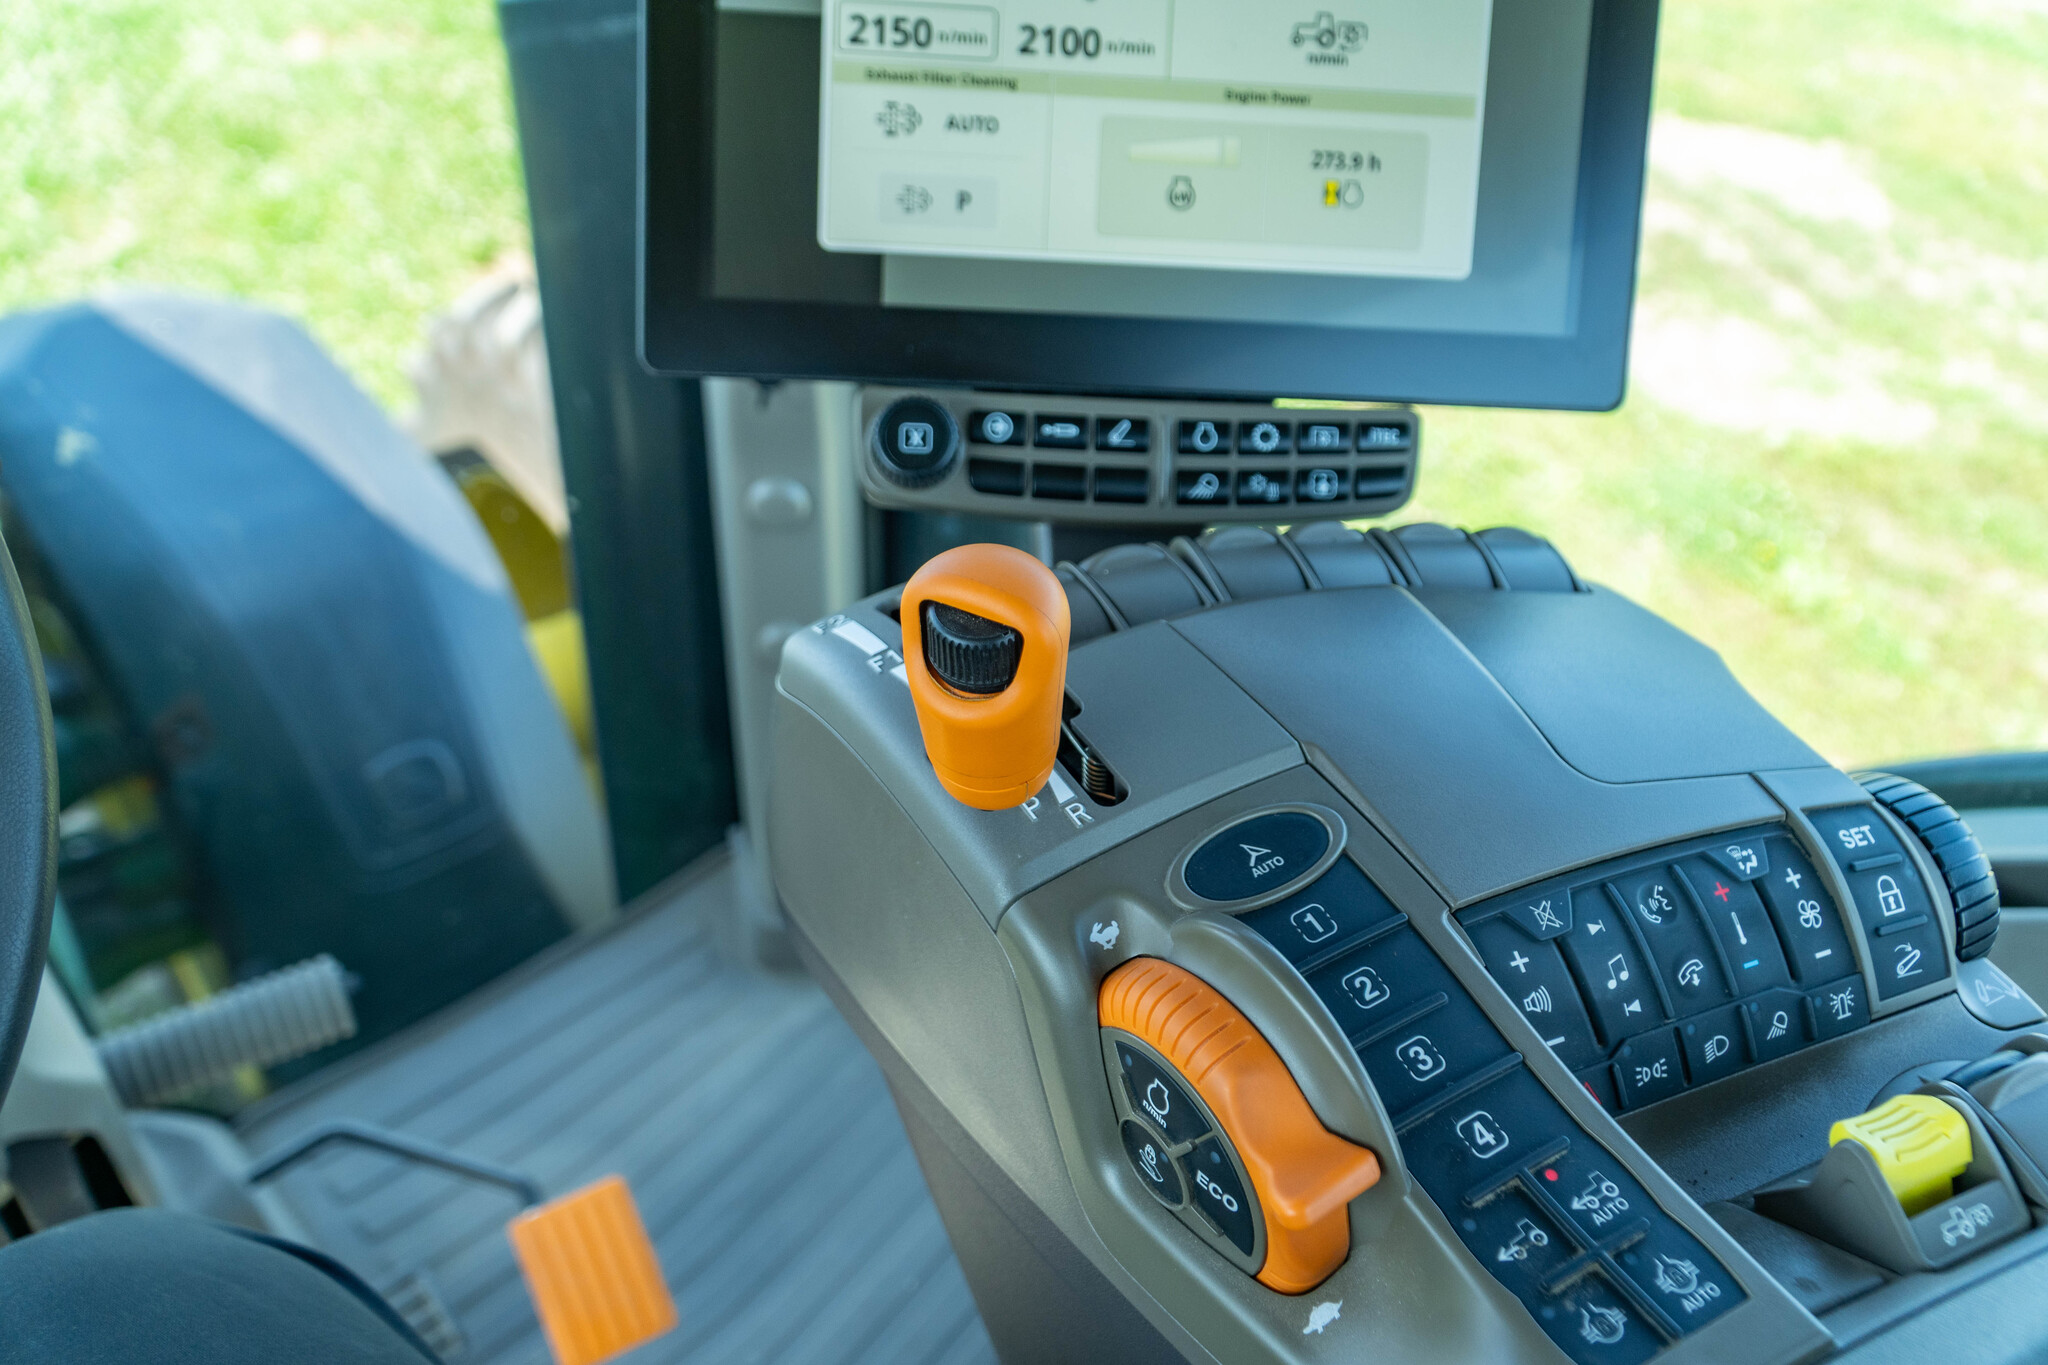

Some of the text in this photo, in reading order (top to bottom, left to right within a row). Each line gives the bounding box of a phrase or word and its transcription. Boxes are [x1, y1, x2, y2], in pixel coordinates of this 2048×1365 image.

[848, 13, 933, 48] 2150
[1018, 23, 1101, 58] 2100
[944, 113, 1000, 134] AUTO
[1368, 151, 1382, 172] h
[956, 189, 973, 213] P
[1021, 796, 1040, 823] P
[1064, 802, 1094, 828] R
[1838, 824, 1876, 849] SET
[1251, 855, 1285, 879] AUTO
[1303, 912, 1324, 934] 1
[1353, 975, 1381, 1001] 2
[1408, 1046, 1435, 1071] 3
[1142, 1098, 1167, 1129] n/min
[1472, 1120, 1497, 1147] 4
[1195, 1169, 1239, 1213] ECO
[1591, 1198, 1630, 1227] AUTO
[1681, 1281, 1721, 1313] AUTO
